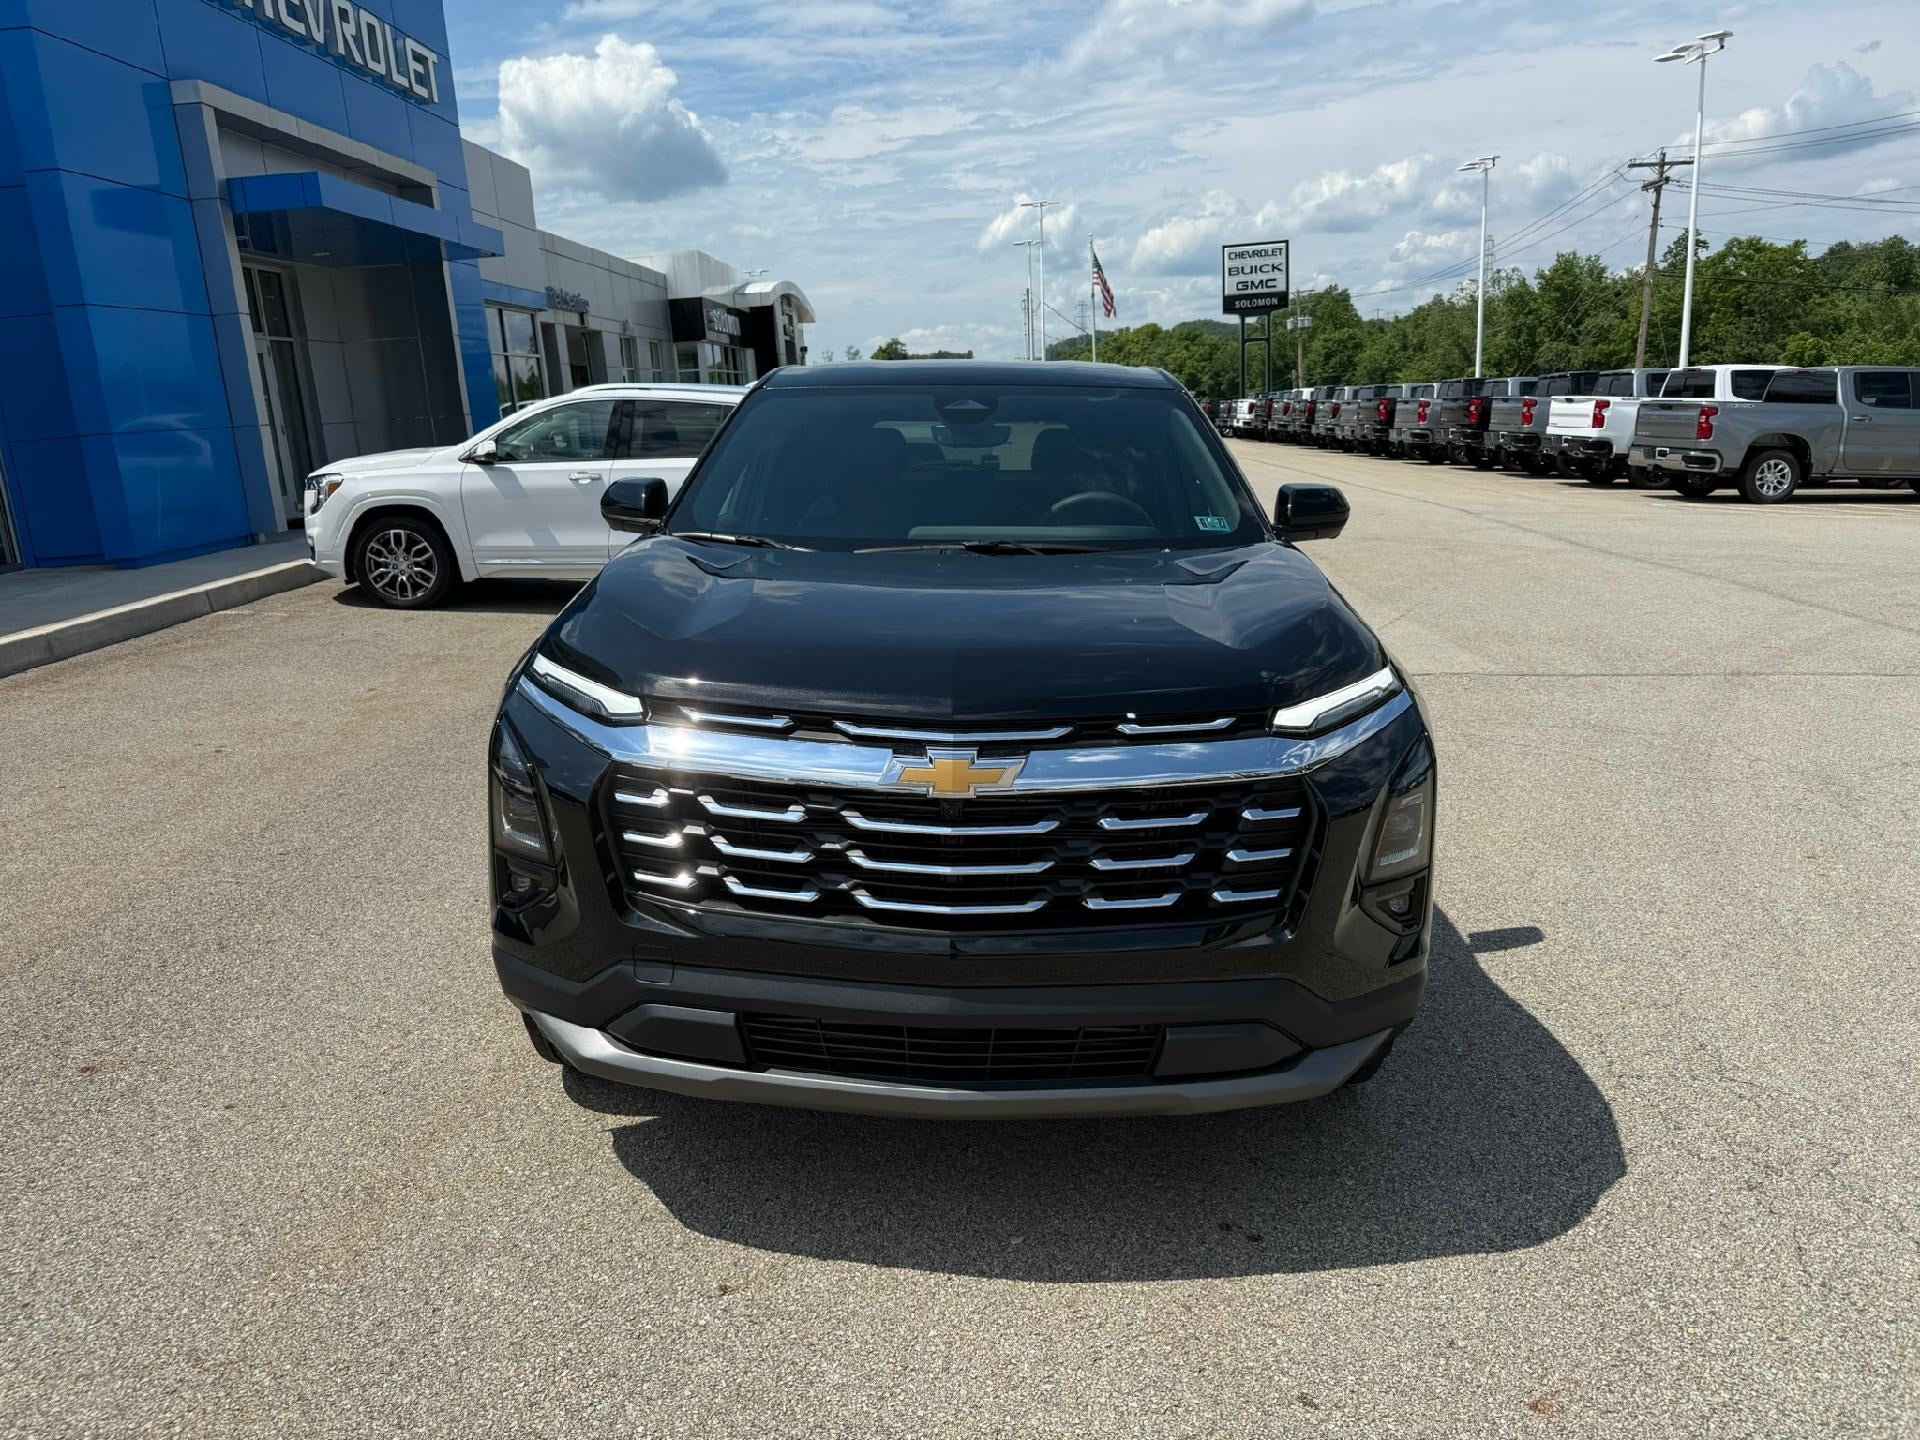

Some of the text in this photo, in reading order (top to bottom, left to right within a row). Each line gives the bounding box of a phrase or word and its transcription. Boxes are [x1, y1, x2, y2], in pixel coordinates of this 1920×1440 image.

[244, 0, 438, 103] EVROLET
[1228, 248, 1283, 260] CHEVROLET
[1228, 263, 1283, 276] BUICK
[1236, 279, 1277, 291] GMC
[1235, 297, 1278, 308] SOLOMON
